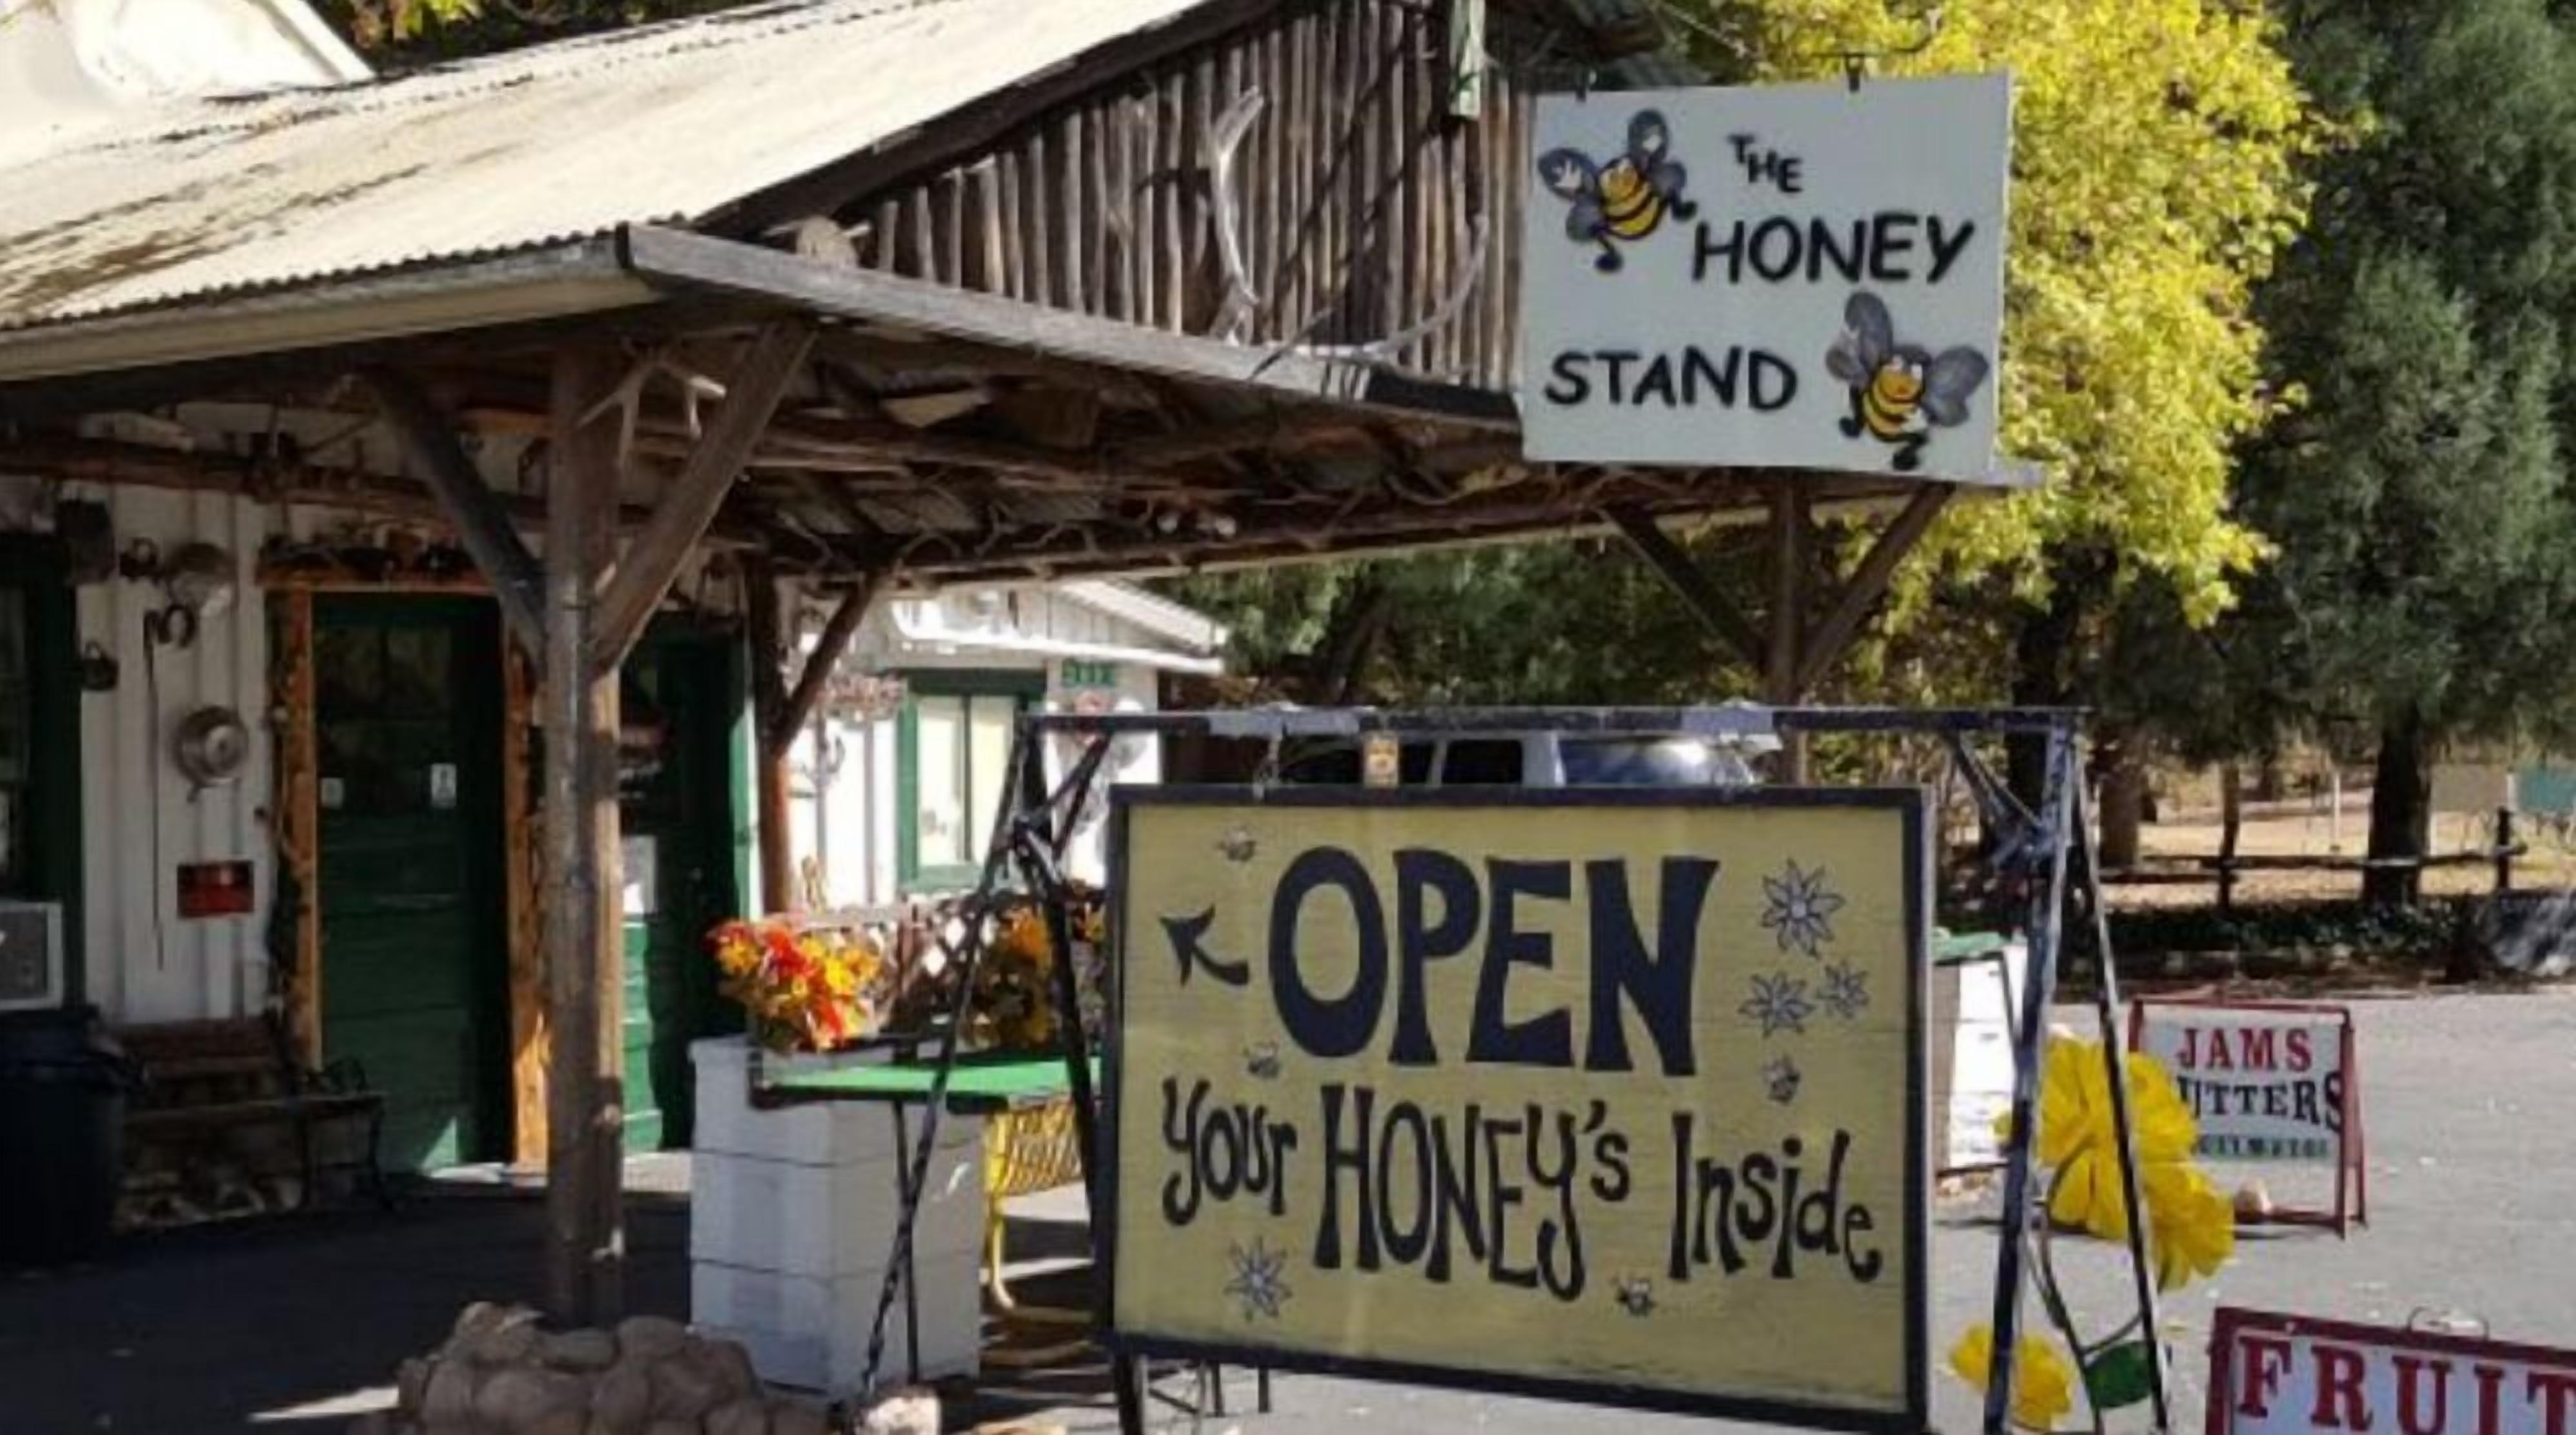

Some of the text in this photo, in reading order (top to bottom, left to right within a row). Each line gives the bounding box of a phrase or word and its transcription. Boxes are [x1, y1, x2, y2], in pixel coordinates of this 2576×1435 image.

[1727, 133, 1804, 194] THE
[1691, 210, 1976, 285] HONEY
[1543, 345, 1799, 414] STAND
[1267, 845, 1721, 1078] OPEN
[2175, 1027, 2313, 1073] JAMS
[2176, 1071, 2345, 1133] UTTERS
[1667, 1110, 1884, 1285] Inside
[2237, 1334, 2576, 1435] FRUIT
